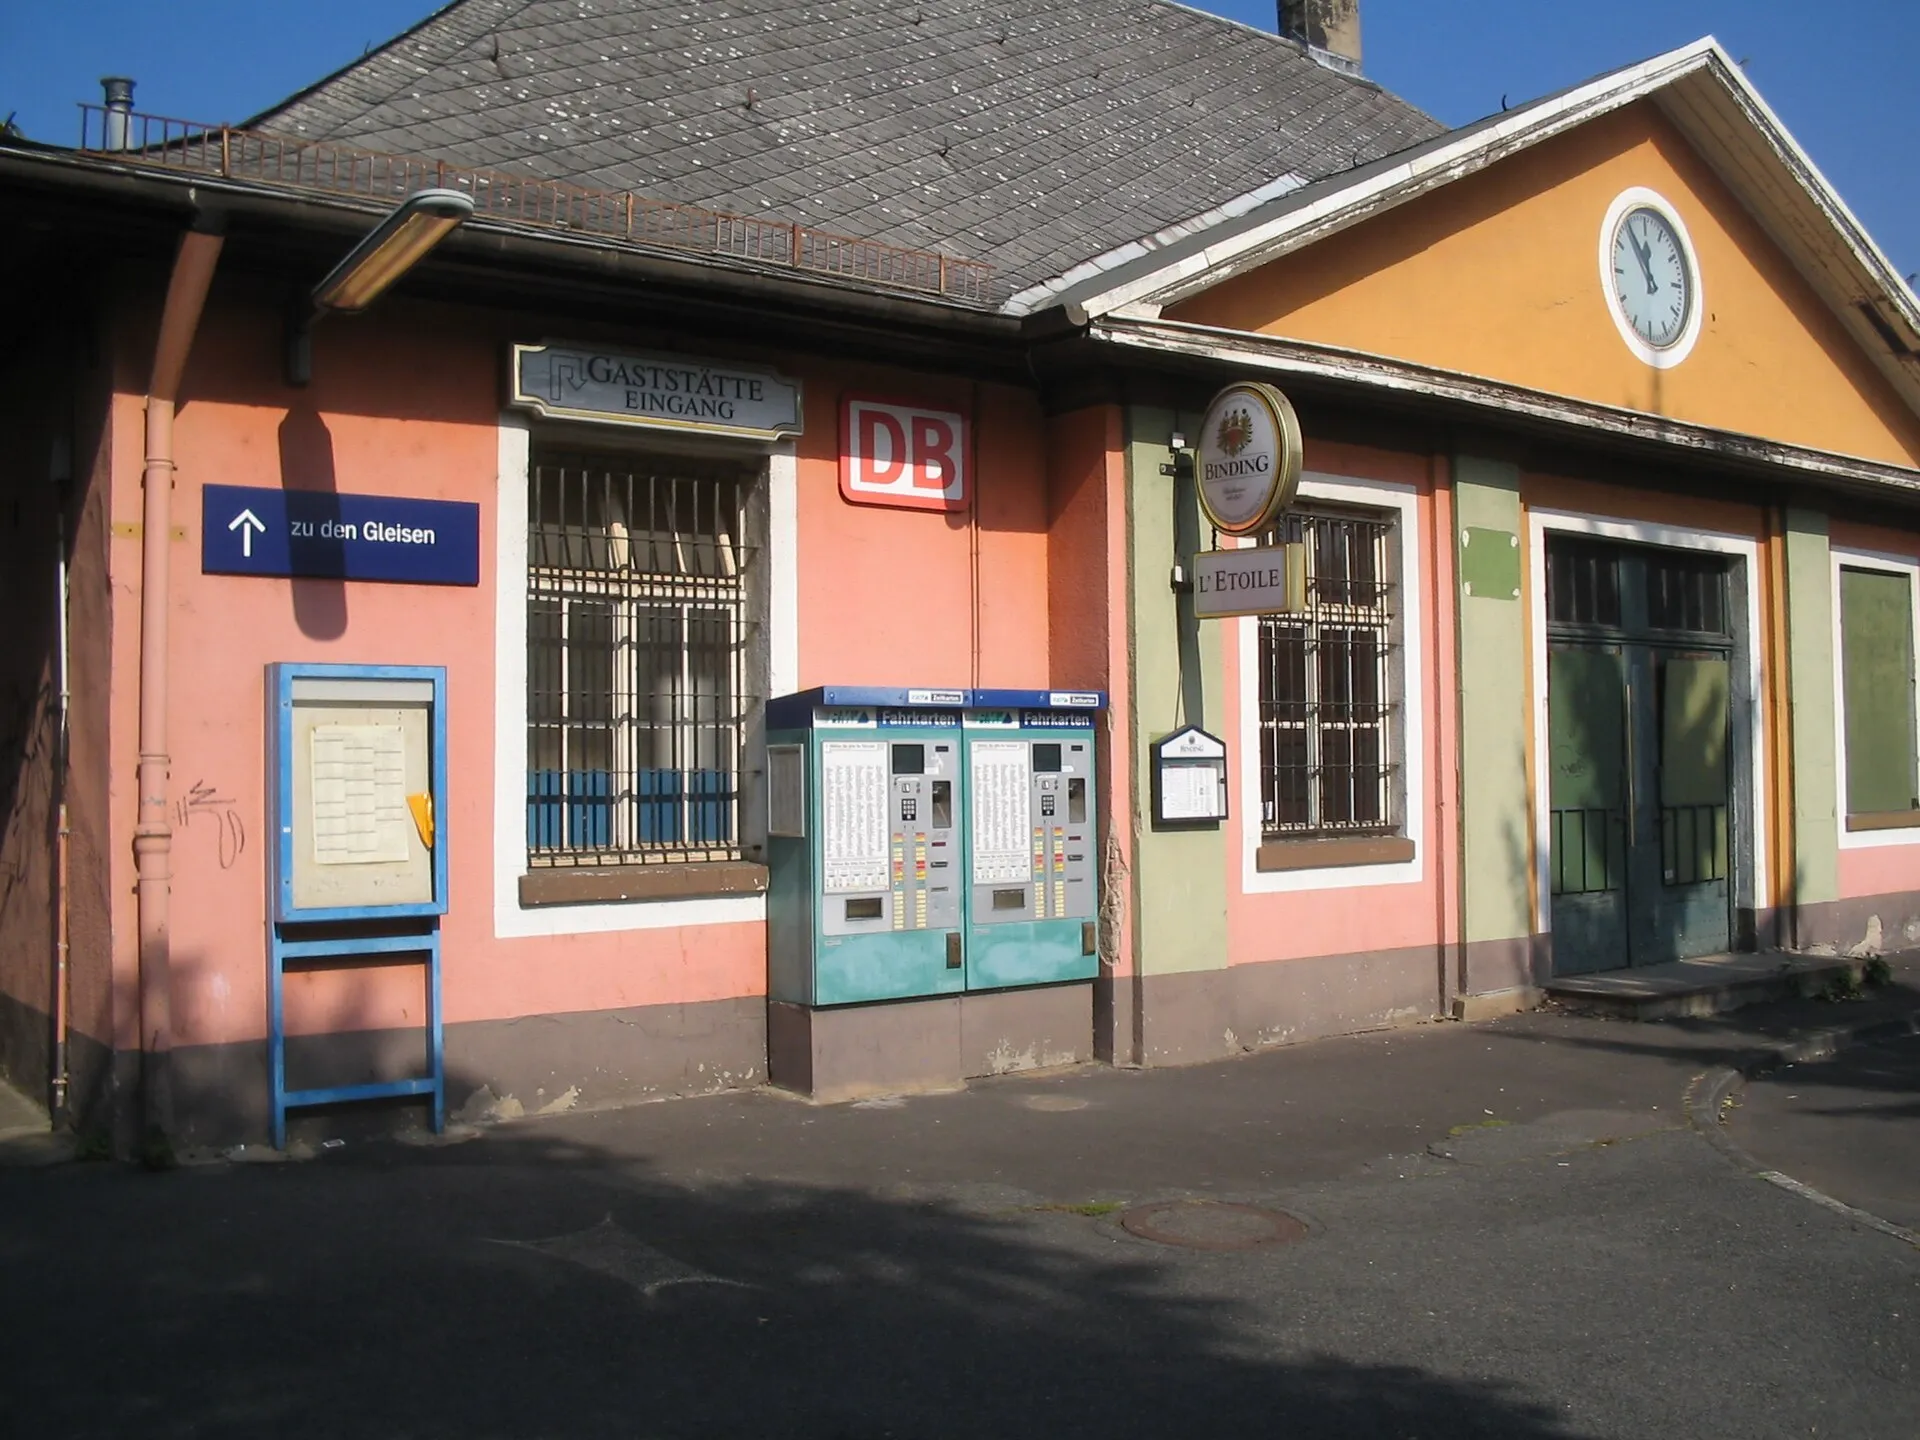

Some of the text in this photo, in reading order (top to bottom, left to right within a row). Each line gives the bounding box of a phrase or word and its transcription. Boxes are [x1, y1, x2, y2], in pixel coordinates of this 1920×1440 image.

[587, 356, 764, 402] GASTSTÄTTE
[625, 391, 735, 420] EINGANG
[858, 409, 956, 490] DB
[1205, 455, 1269, 481] BINDING
[291, 519, 436, 545] zu den Gleisen
[882, 710, 956, 726] Fahrkarten
[1024, 711, 1090, 727] Fahrkarten
